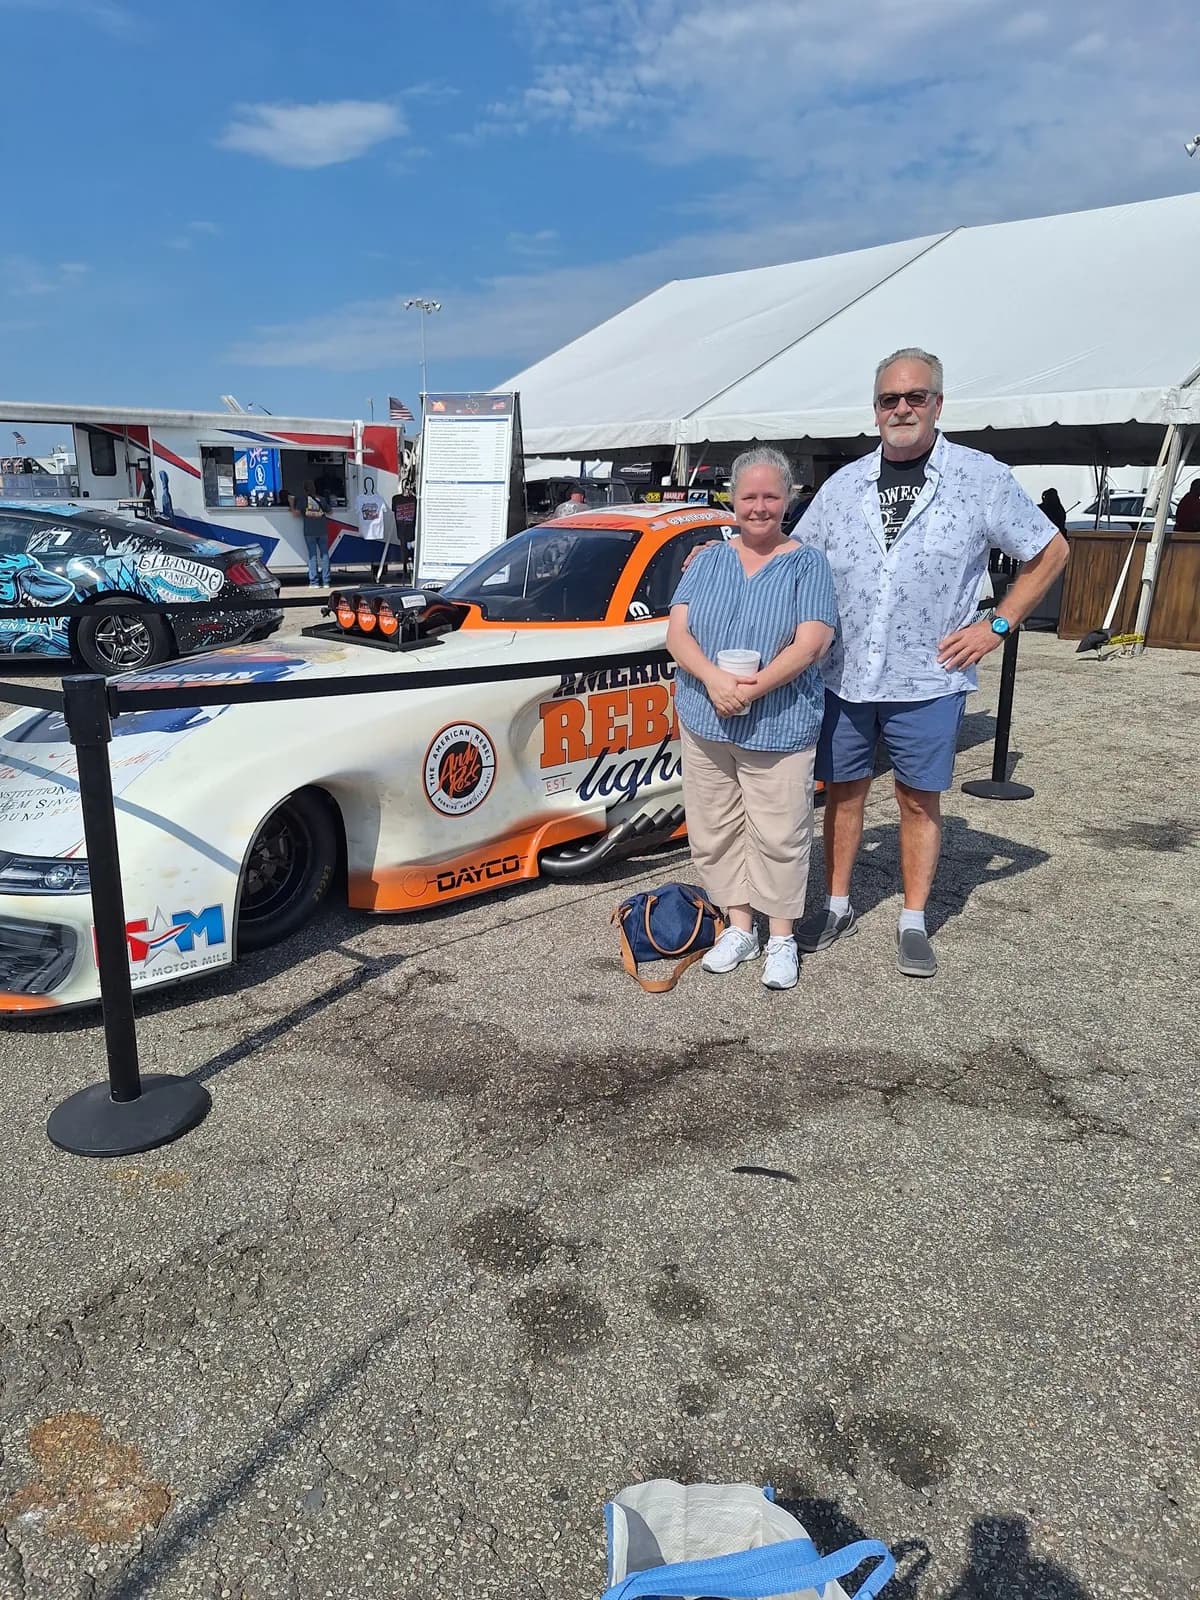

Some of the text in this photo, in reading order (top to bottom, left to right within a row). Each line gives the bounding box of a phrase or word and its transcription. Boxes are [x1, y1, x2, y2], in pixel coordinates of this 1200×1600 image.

[878, 485, 922, 506] DWES
[161, 555, 224, 592] BANDIDO
[552, 661, 678, 698] AMERIC
[539, 681, 681, 769] REB
[432, 728, 471, 760] AMERICAN
[474, 734, 492, 762] REBEL
[546, 777, 567, 792] EST
[575, 733, 682, 813] ligh
[0, 785, 66, 799] NSTITUTION
[0, 799, 32, 811] HEM
[0, 811, 45, 823] OUND
[437, 854, 521, 893] DAYCO
[152, 951, 229, 978] MOTOR MILE
